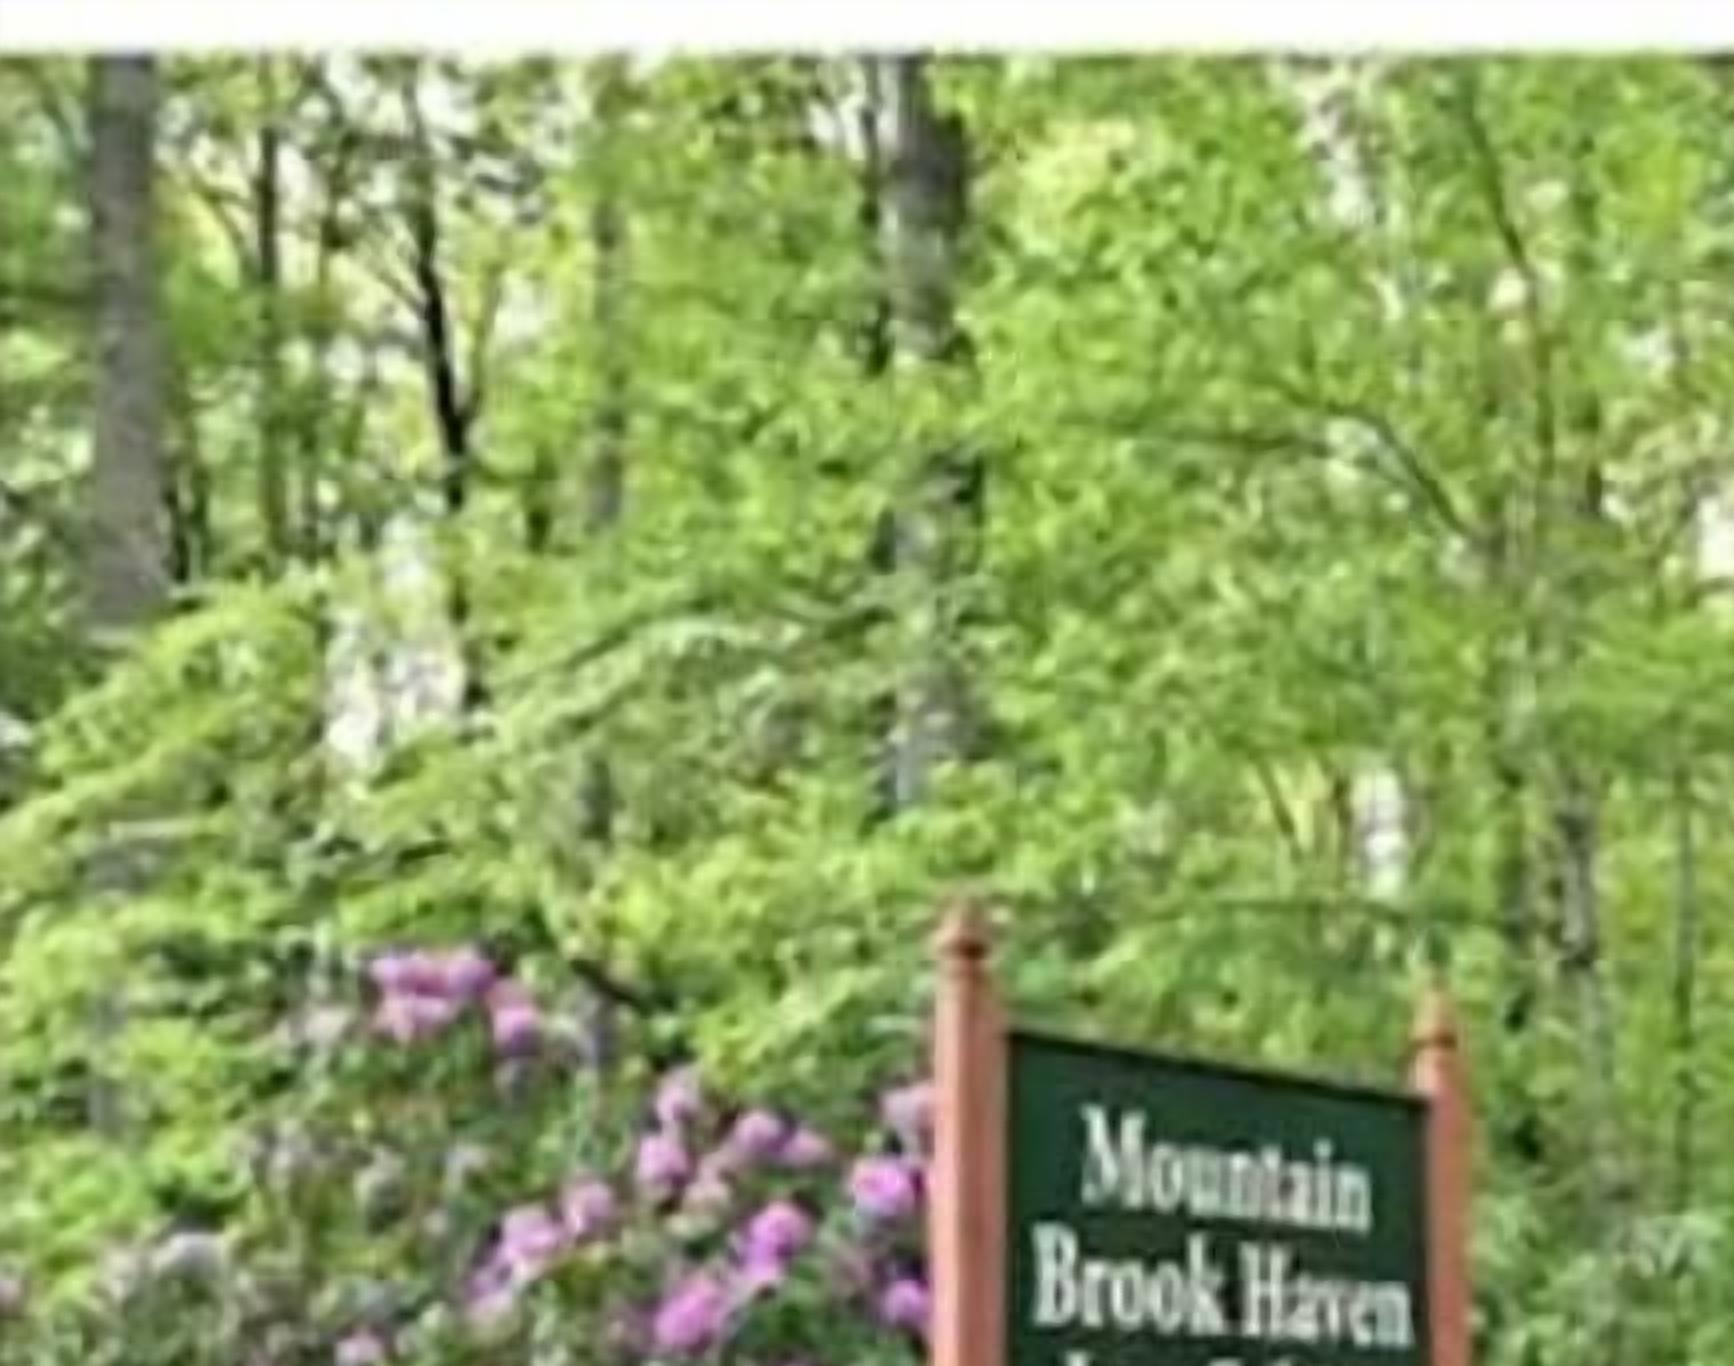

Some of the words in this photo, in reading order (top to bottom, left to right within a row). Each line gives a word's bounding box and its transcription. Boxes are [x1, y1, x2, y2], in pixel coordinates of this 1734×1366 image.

[1080, 1103, 1374, 1234] Mountain
[1031, 1221, 1225, 1336] Brook
[1239, 1241, 1415, 1348] Haven
